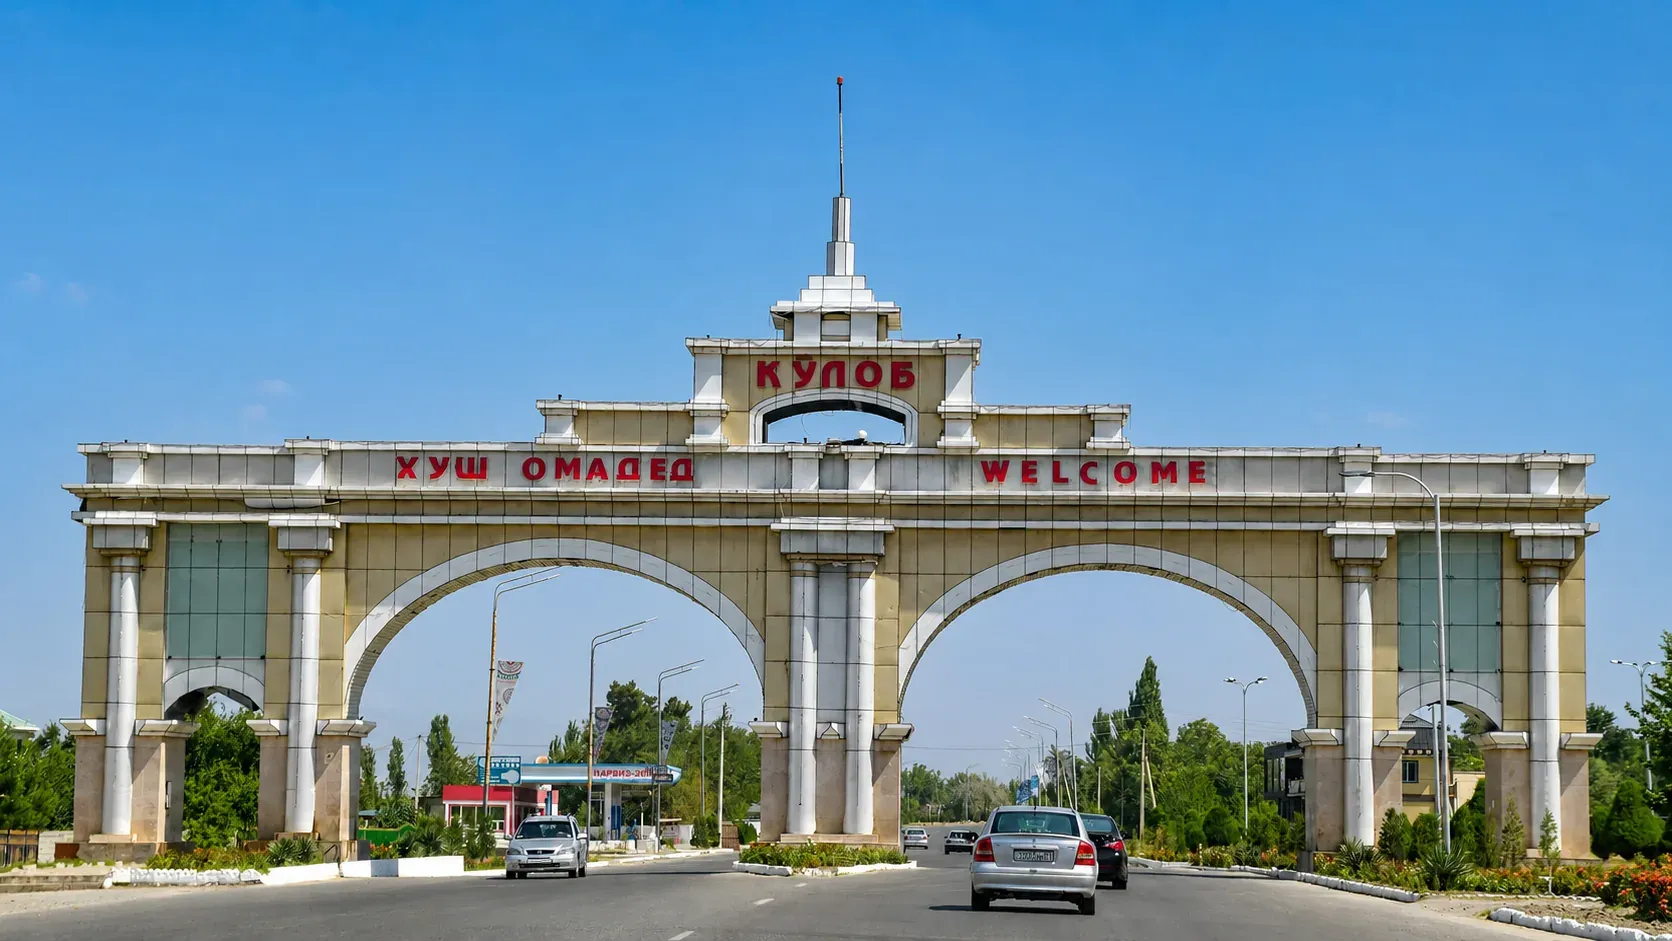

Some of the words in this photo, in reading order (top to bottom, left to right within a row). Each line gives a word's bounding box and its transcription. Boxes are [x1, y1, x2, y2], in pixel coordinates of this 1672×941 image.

[397, 456, 488, 480] ХУШ
[522, 457, 694, 481] ОМАДЕД
[981, 460, 1206, 485] WELCOME
